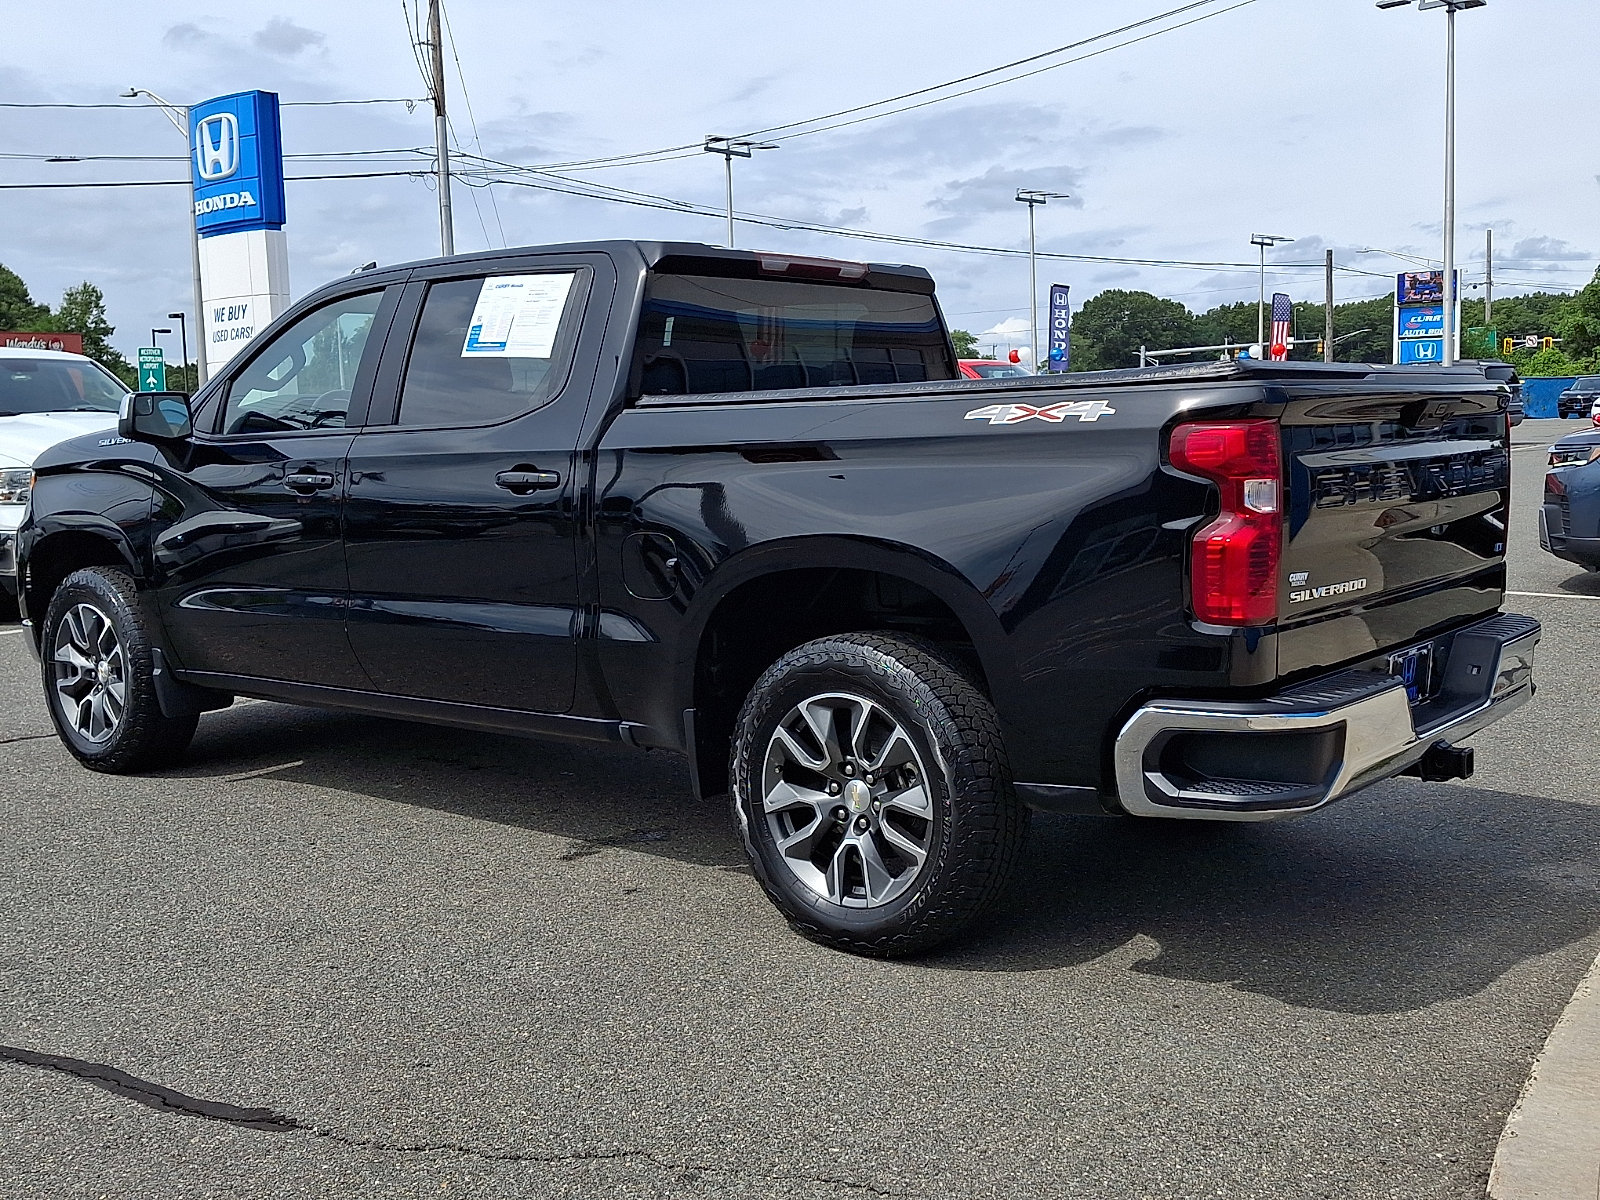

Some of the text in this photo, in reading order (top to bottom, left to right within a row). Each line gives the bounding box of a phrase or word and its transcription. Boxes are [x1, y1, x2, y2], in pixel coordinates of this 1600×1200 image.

[194, 191, 257, 217] HONDA
[213, 303, 248, 323] WE BUY
[1410, 315, 1443, 323] CURR
[6, 335, 48, 349] Wendy's
[212, 325, 254, 344] USED CARS!
[1053, 308, 1068, 361] HOND
[1403, 328, 1427, 337] AUTO
[142, 362, 159, 370] AIRPORT
[1289, 578, 1367, 604] SILVERADO
